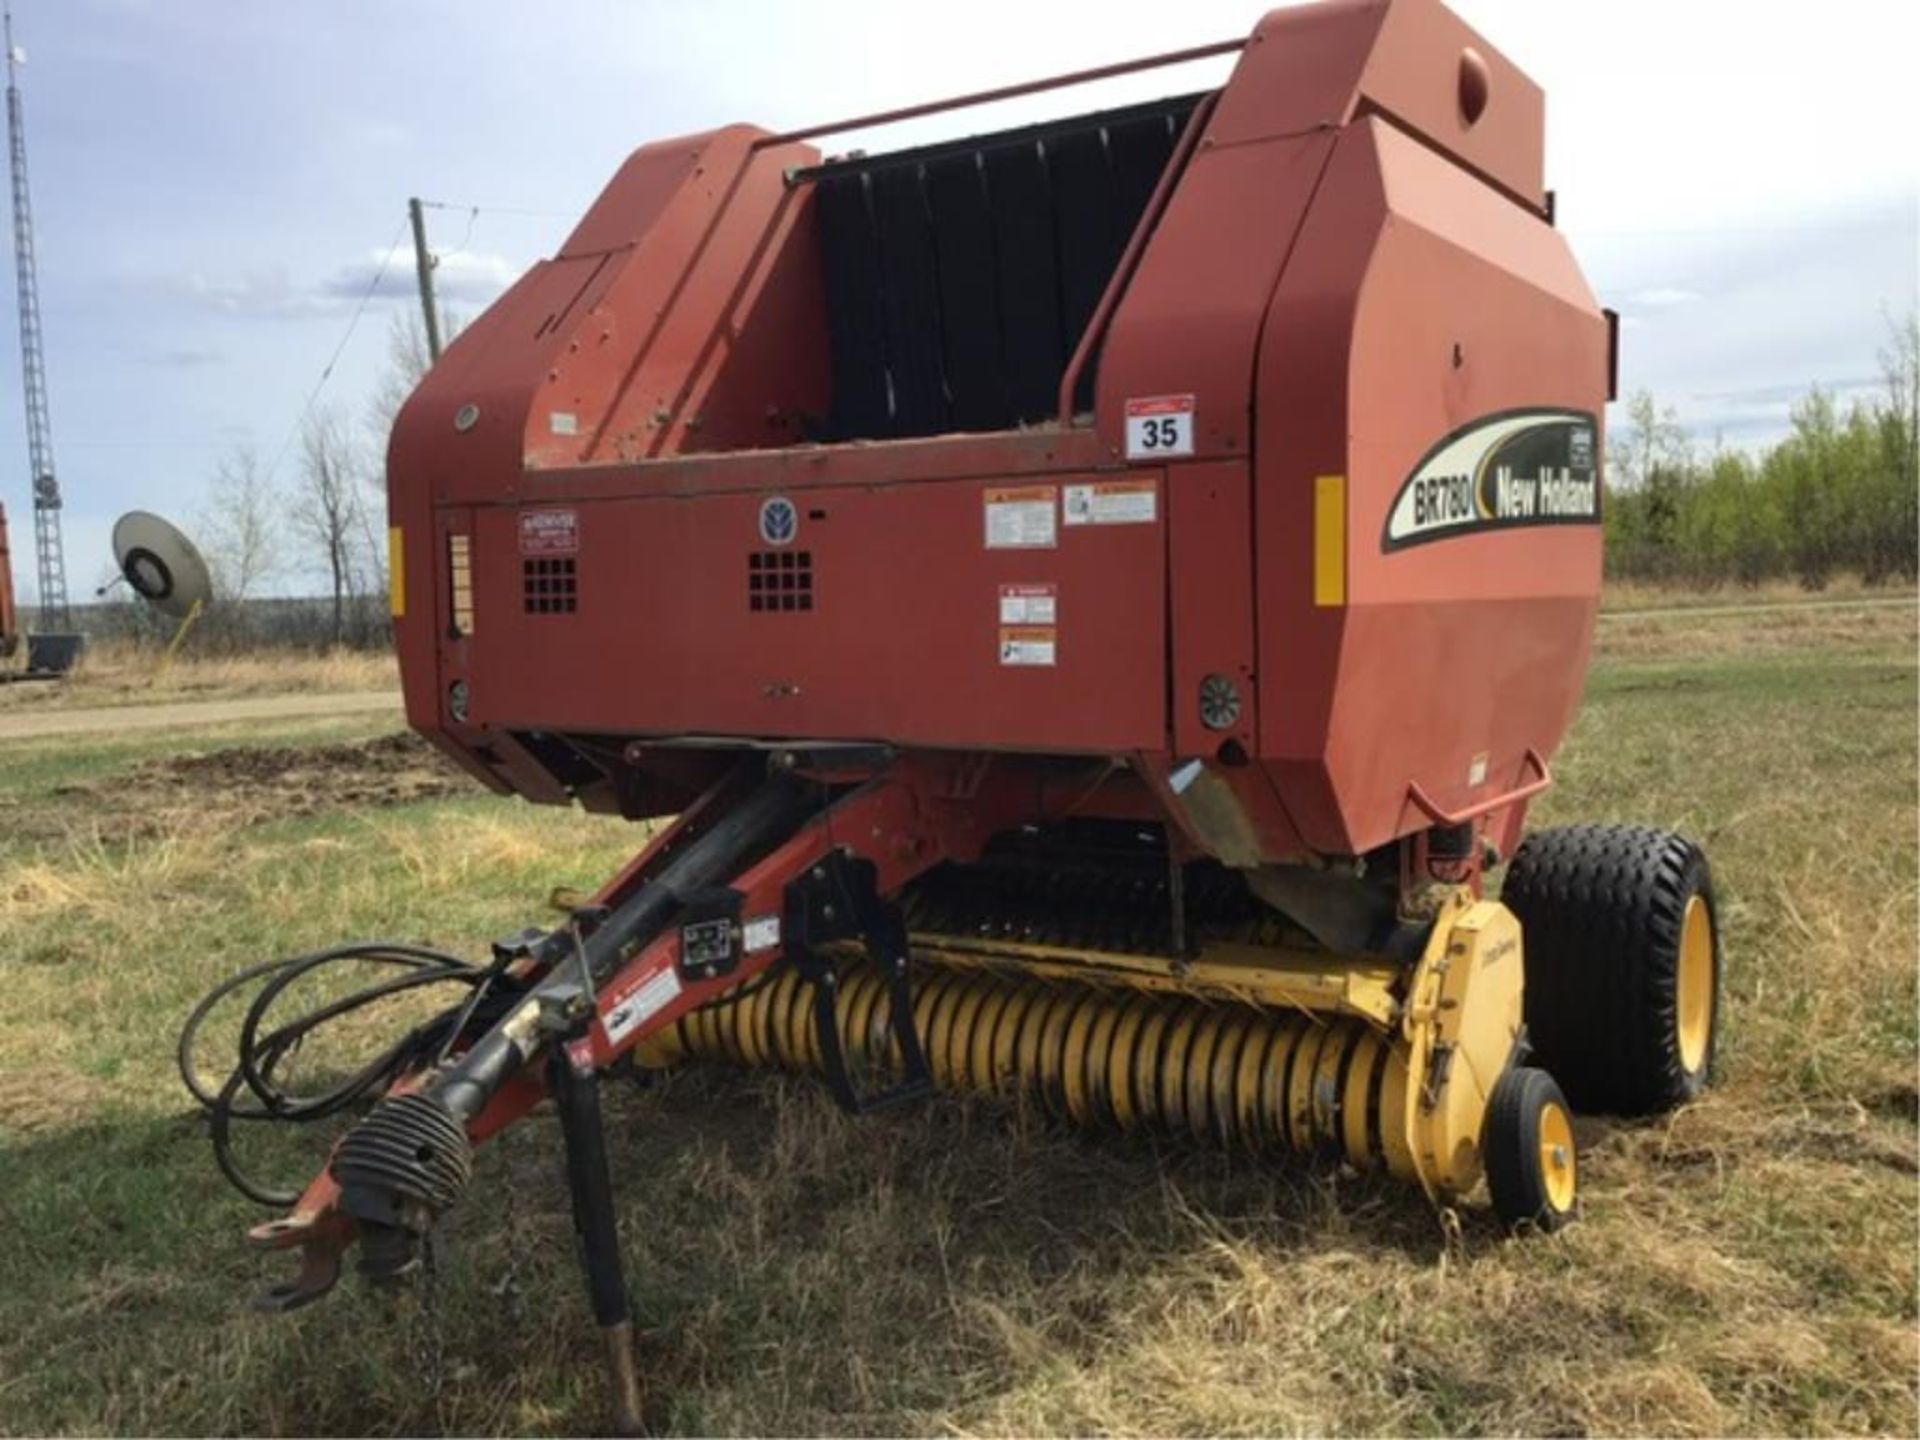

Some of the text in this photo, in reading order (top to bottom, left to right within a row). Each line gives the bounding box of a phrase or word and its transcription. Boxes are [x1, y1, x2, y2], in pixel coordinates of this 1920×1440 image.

[1141, 418, 1178, 449] 35
[1414, 475, 1471, 525] BR780
[1496, 465, 1596, 518] New Holland
